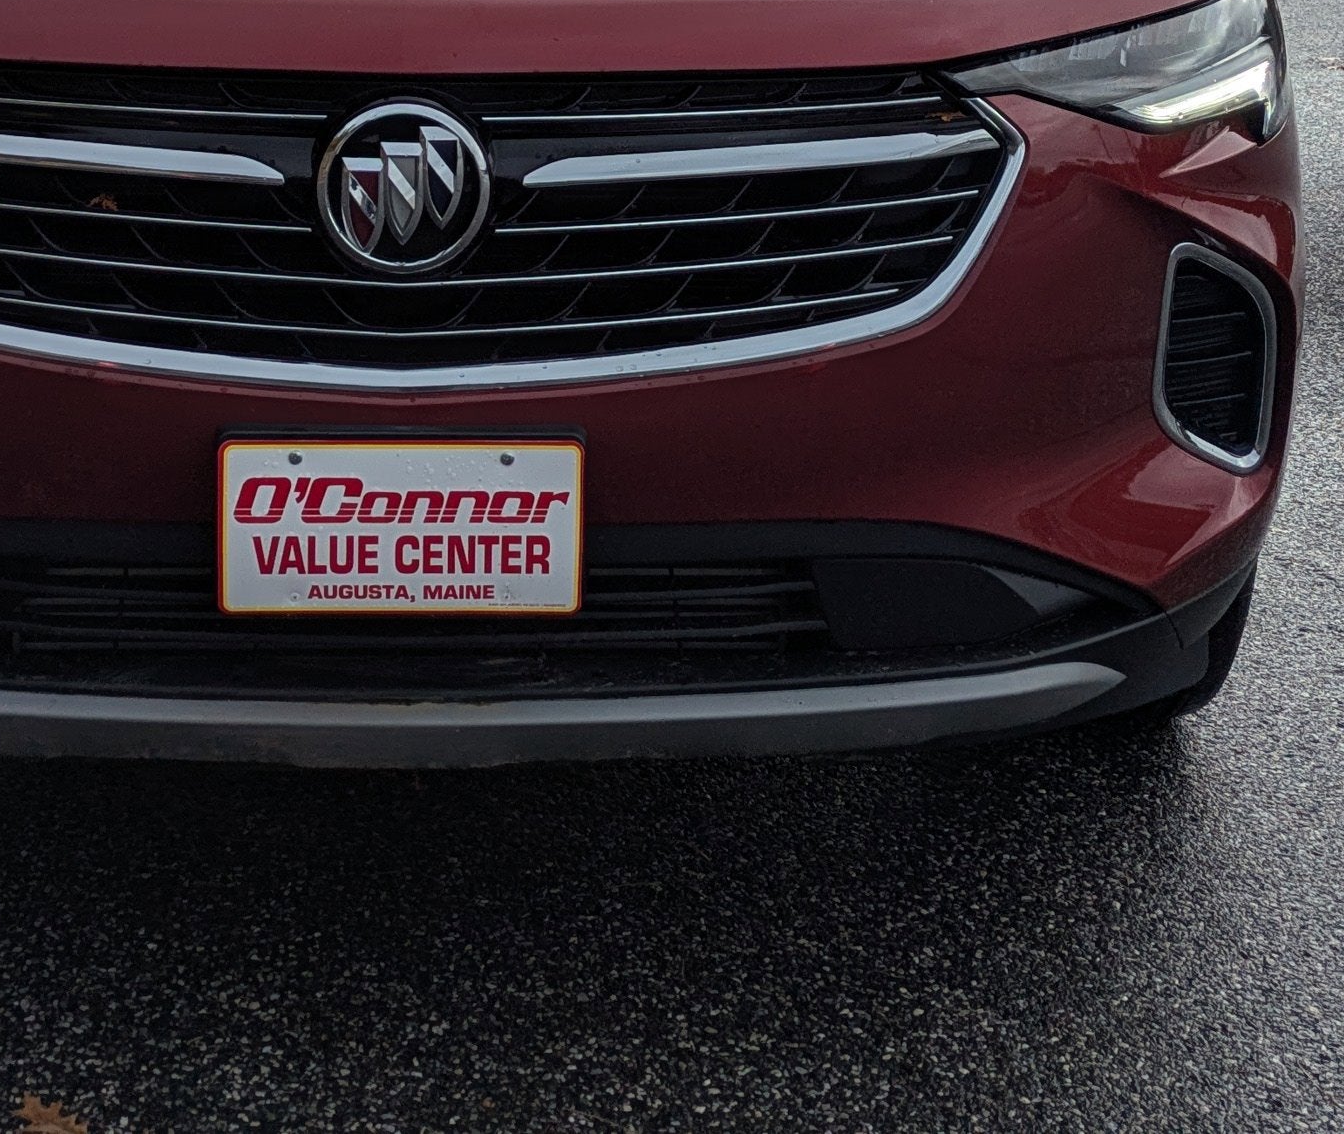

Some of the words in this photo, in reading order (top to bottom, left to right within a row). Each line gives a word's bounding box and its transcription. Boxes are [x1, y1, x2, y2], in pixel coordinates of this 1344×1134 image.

[233, 477, 571, 524] O'Connor
[252, 535, 379, 575] VALUE
[394, 535, 551, 575] CENTER
[308, 584, 416, 603] AUGUSTA,
[423, 584, 495, 599] MAINE
